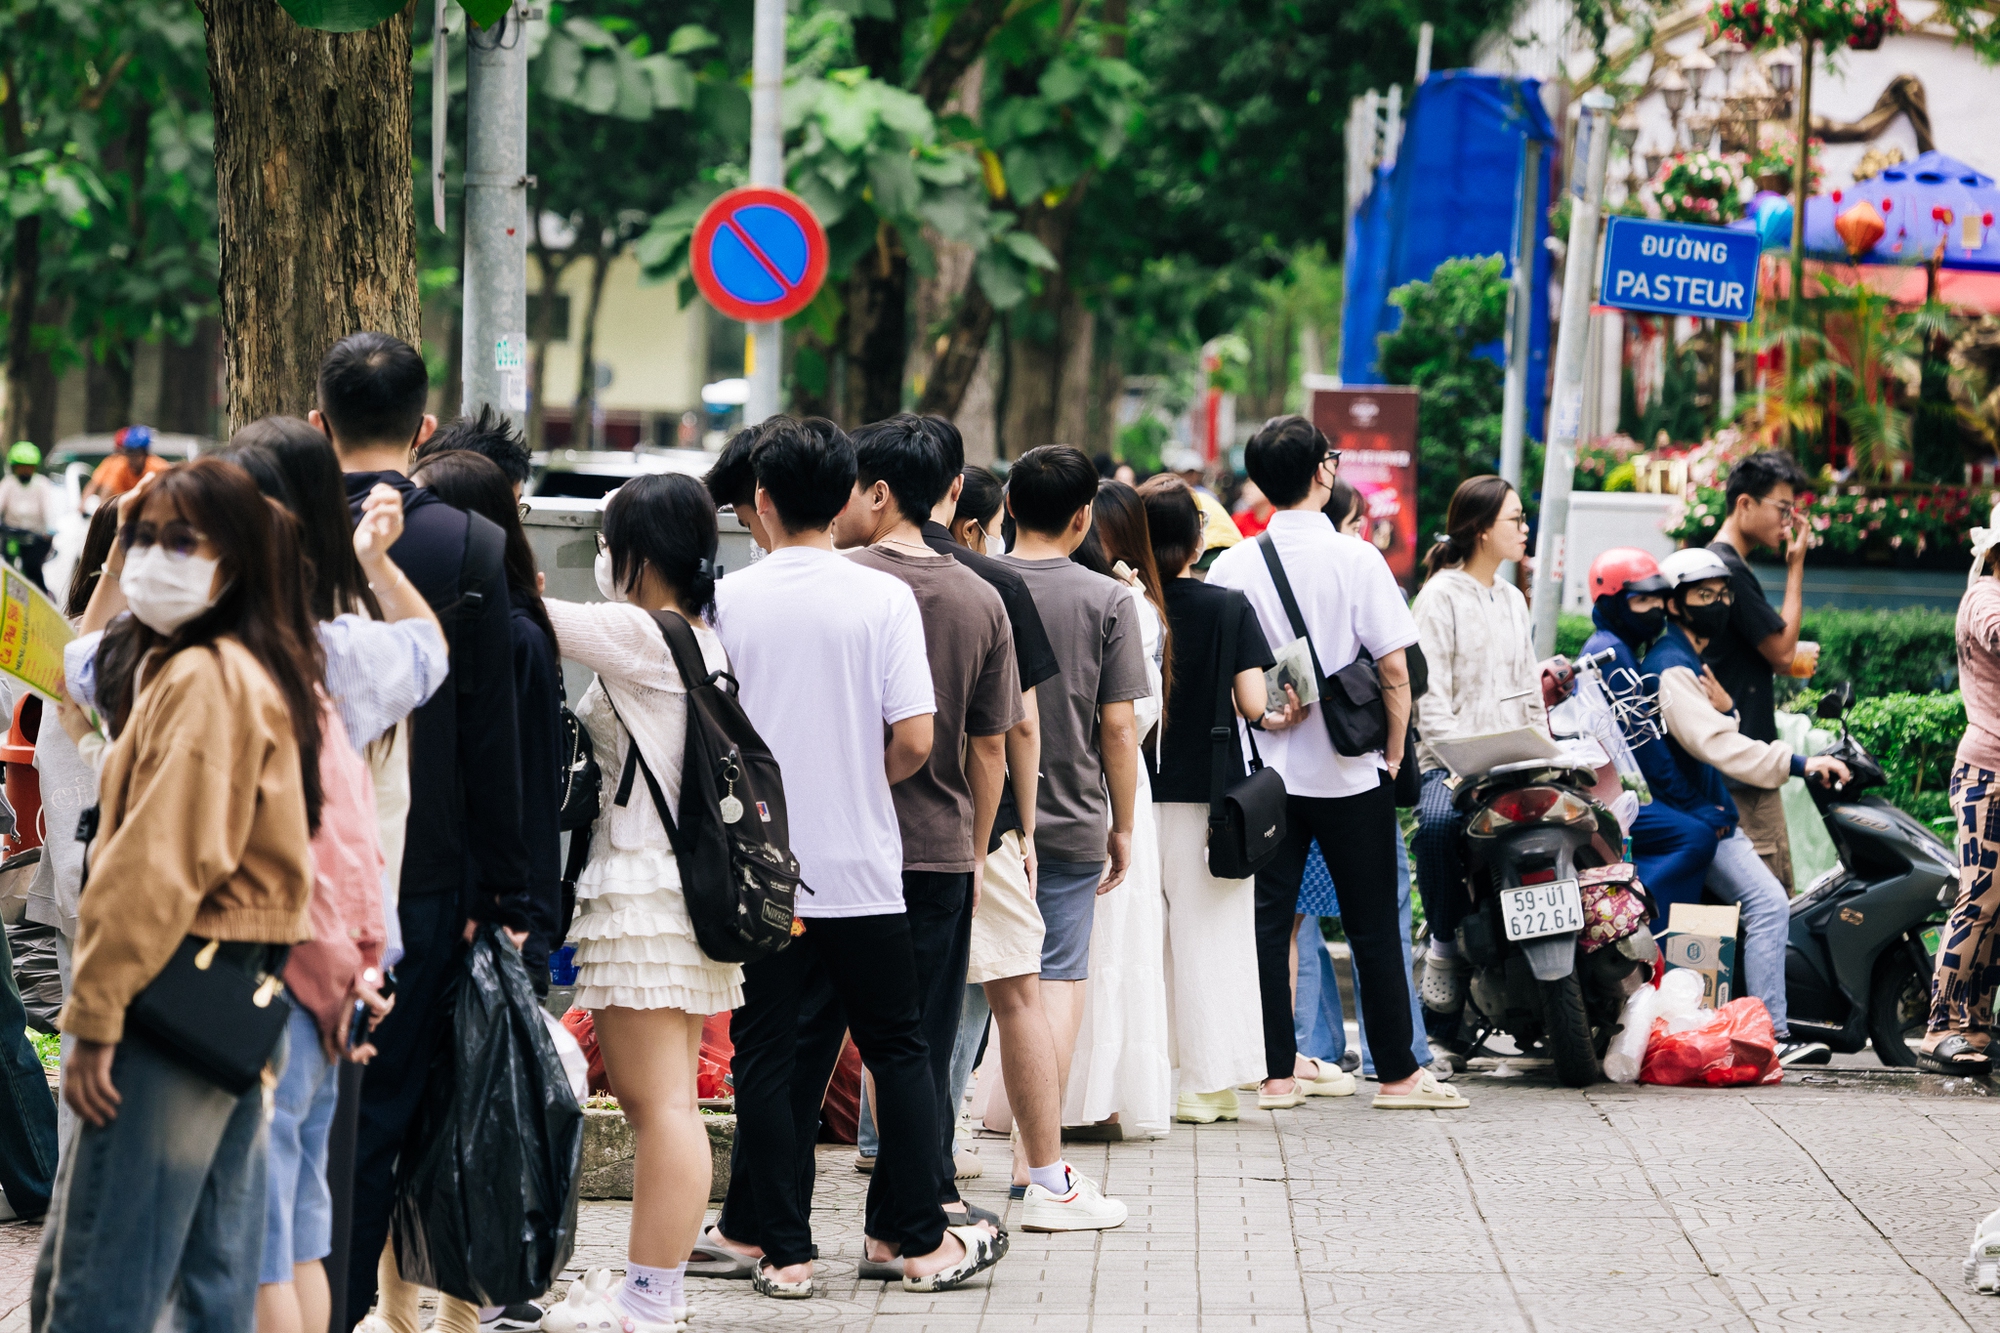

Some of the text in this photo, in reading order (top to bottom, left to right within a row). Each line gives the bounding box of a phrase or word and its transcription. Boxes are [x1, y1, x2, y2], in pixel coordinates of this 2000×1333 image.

[1641, 233, 1728, 264] ĐƯỜNG
[1615, 269, 1745, 310] PASTEUR
[1514, 886, 1565, 912] 59-U1
[1511, 907, 1577, 936] 622.64
